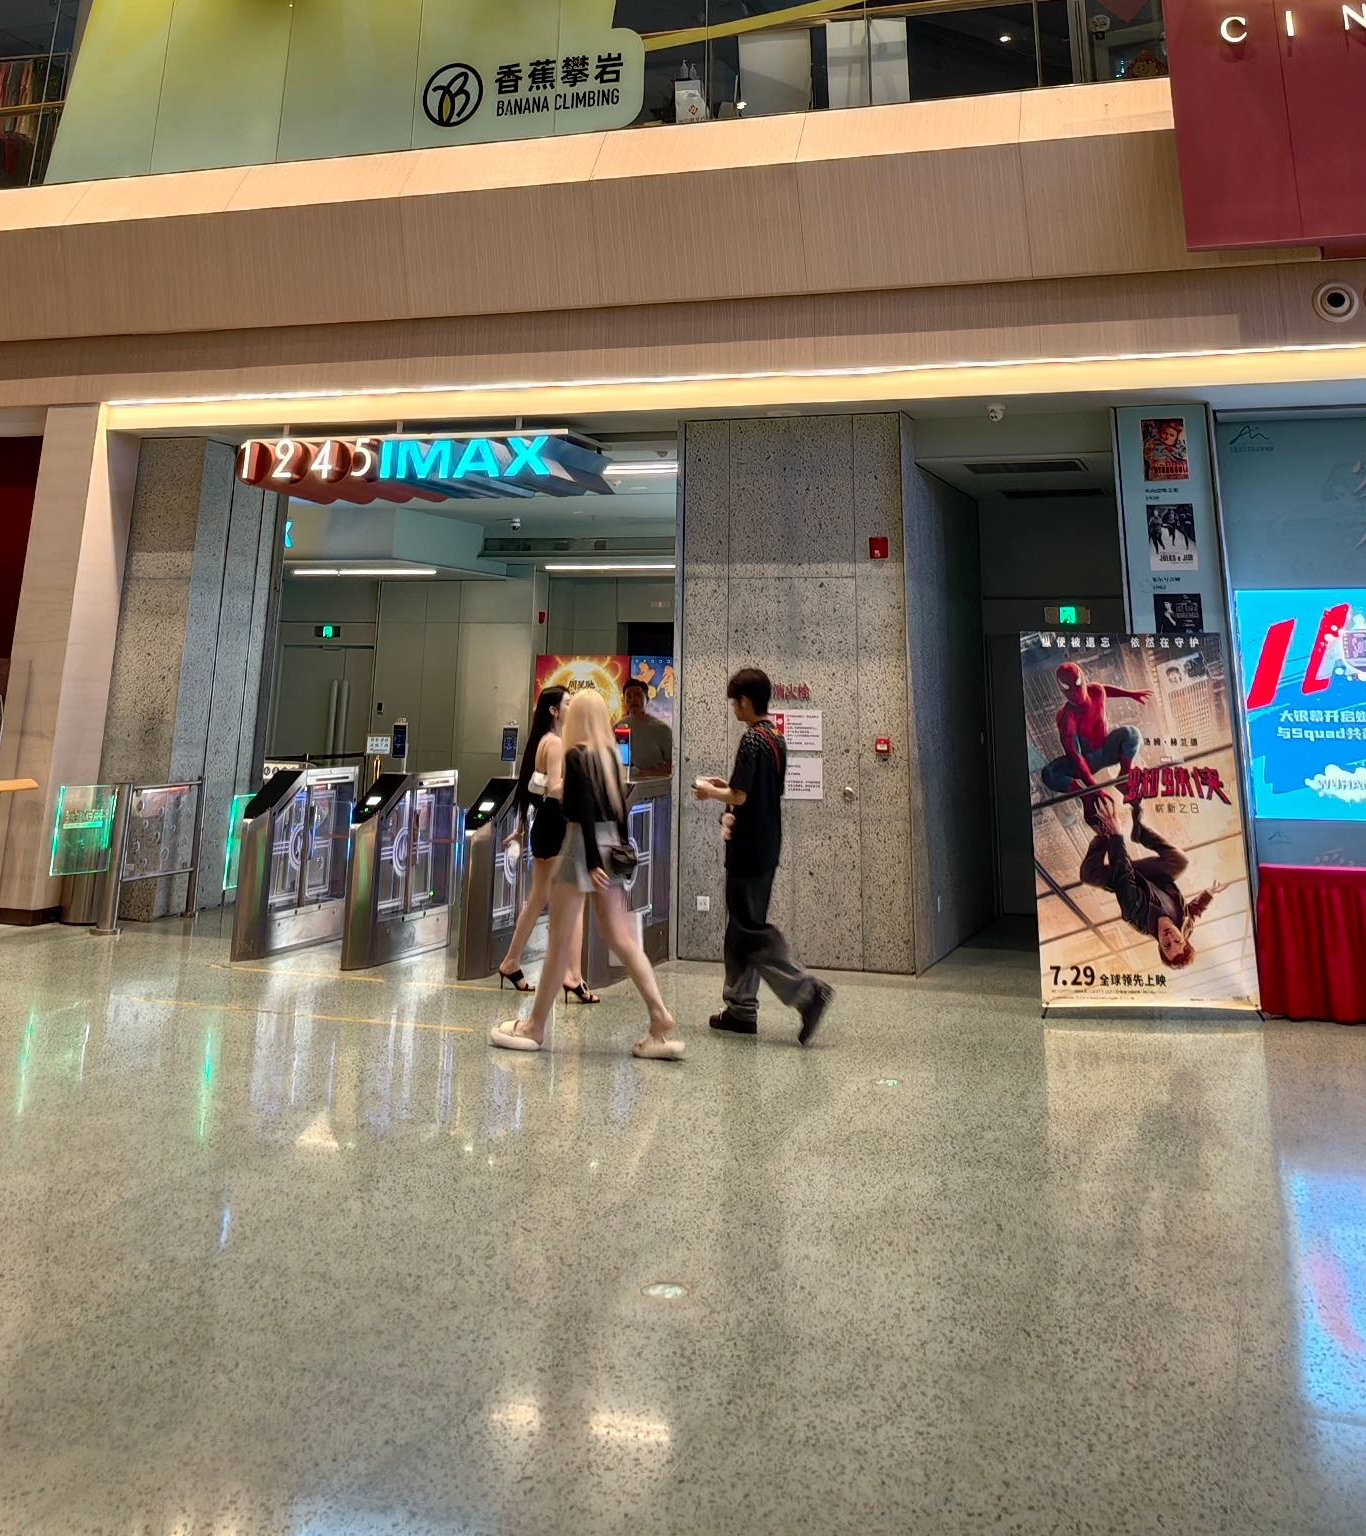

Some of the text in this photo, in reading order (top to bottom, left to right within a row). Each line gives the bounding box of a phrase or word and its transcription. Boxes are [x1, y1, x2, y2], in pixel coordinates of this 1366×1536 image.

[493, 51, 624, 95] 香蕉攀岩
[496, 88, 620, 117] BANANA CLIMBING
[379, 436, 551, 479] IMAX
[1130, 636, 1200, 649] 依然在守护
[1049, 965, 1168, 988] 7.29 全球领先上映
